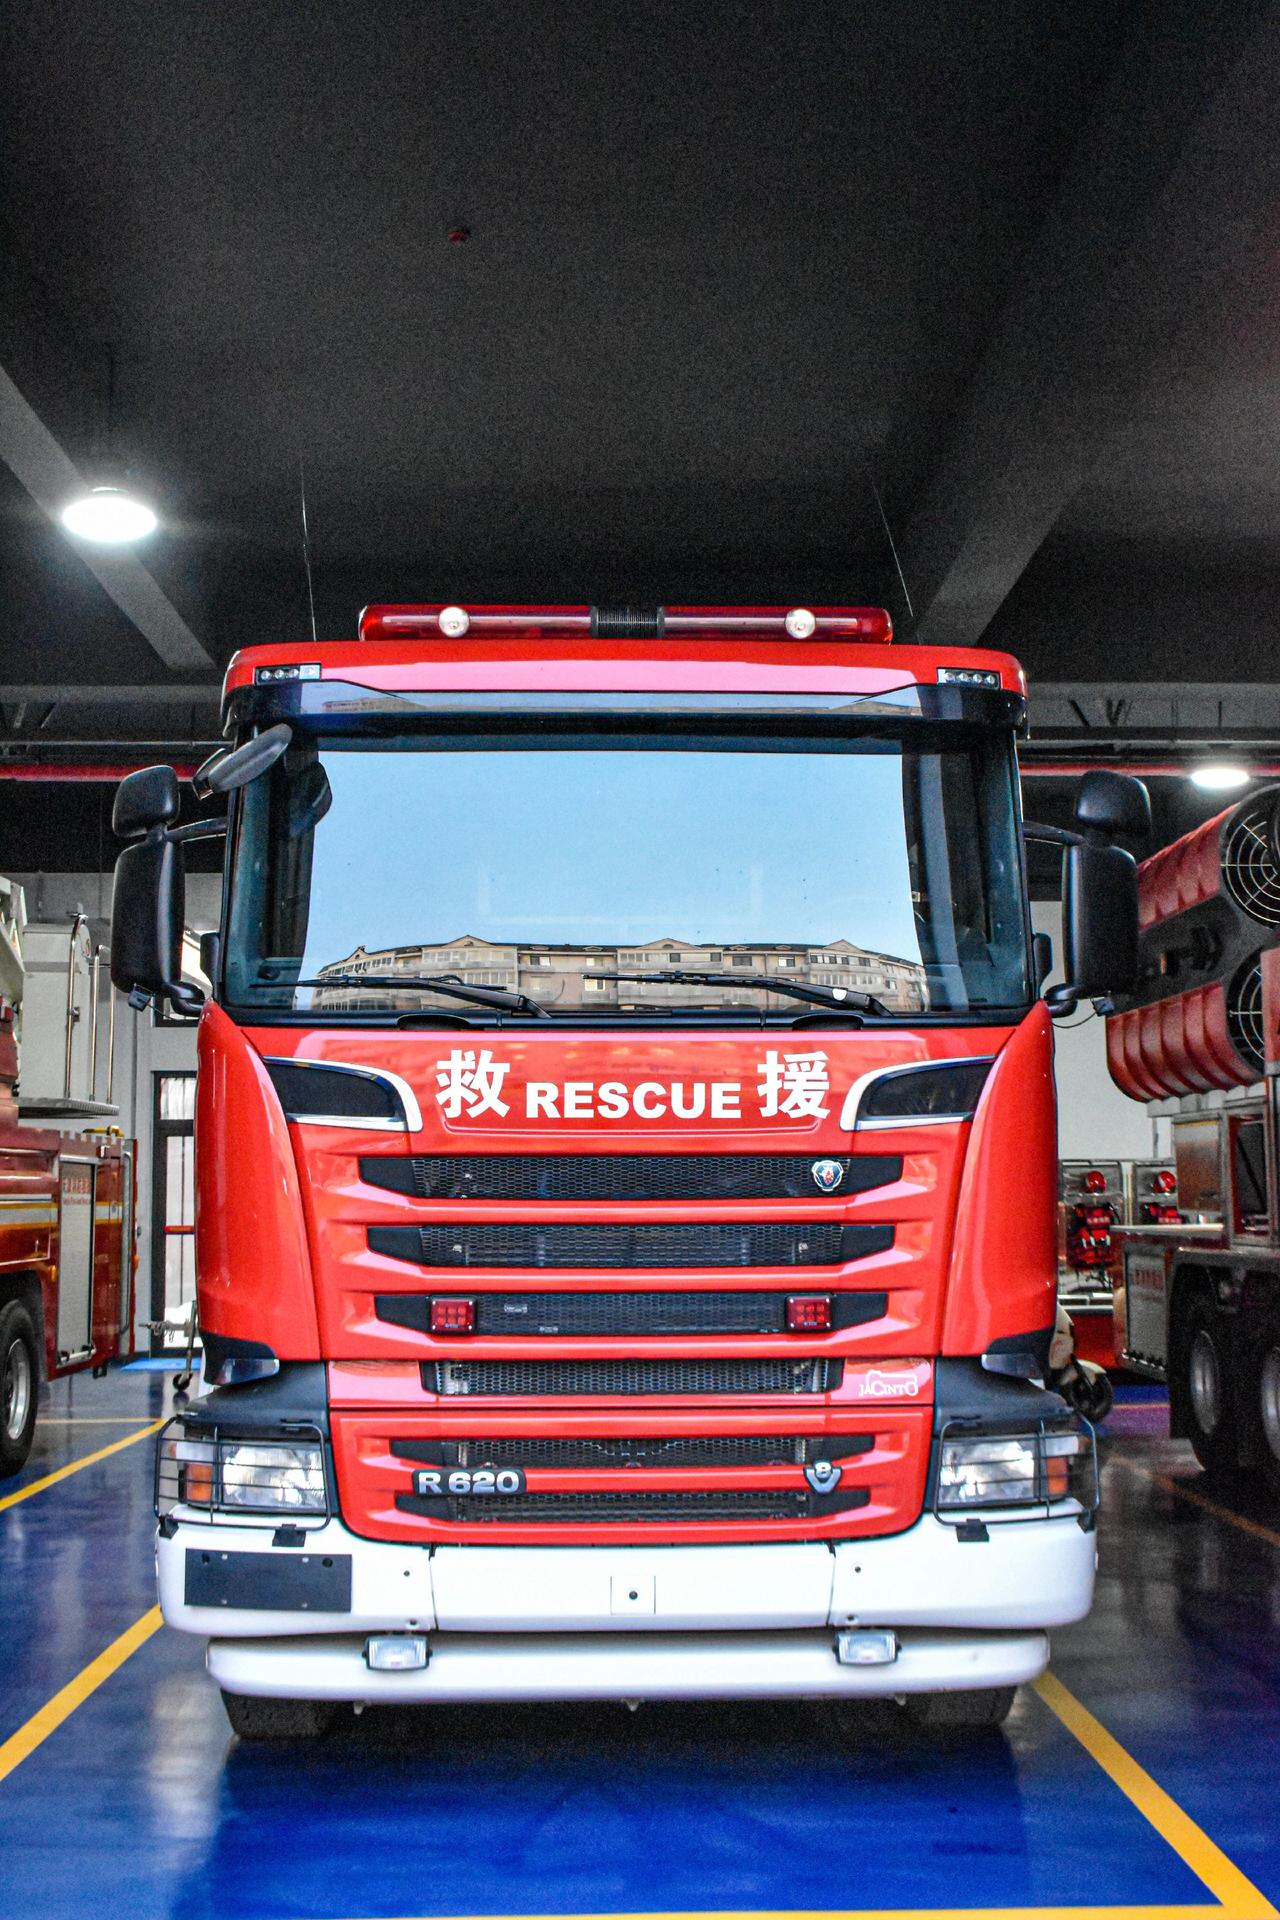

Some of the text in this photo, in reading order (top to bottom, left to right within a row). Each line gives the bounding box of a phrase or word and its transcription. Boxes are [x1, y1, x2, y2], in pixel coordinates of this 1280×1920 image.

[435, 1049, 831, 1119] 救 RESCUE 援
[418, 1471, 520, 1494] R 620
